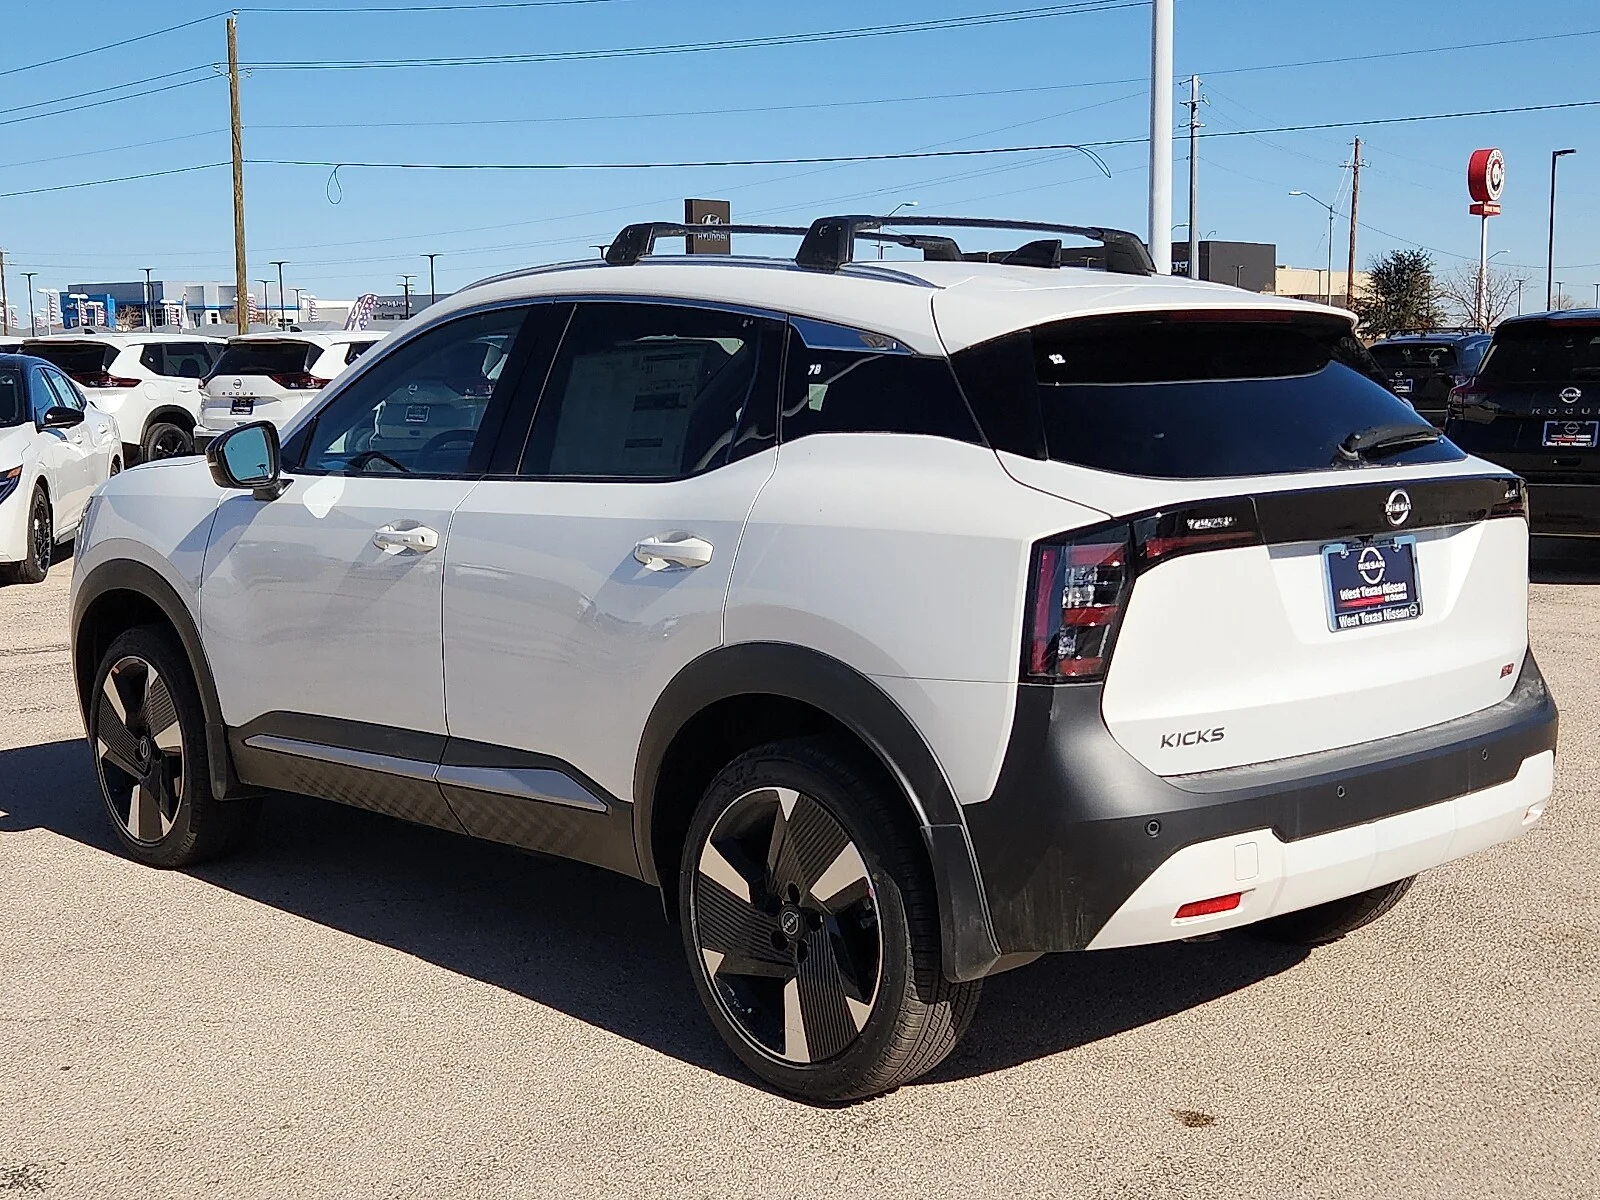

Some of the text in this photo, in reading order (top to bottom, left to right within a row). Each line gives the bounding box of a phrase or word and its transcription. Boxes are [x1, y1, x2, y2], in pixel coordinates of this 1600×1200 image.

[697, 232, 728, 241] HYUNDAI
[1358, 560, 1385, 571] NISSAN
[1340, 582, 1407, 601] West Texas Nissan
[1339, 607, 1410, 628] West Texas Nissan
[1160, 726, 1225, 749] KICKS
